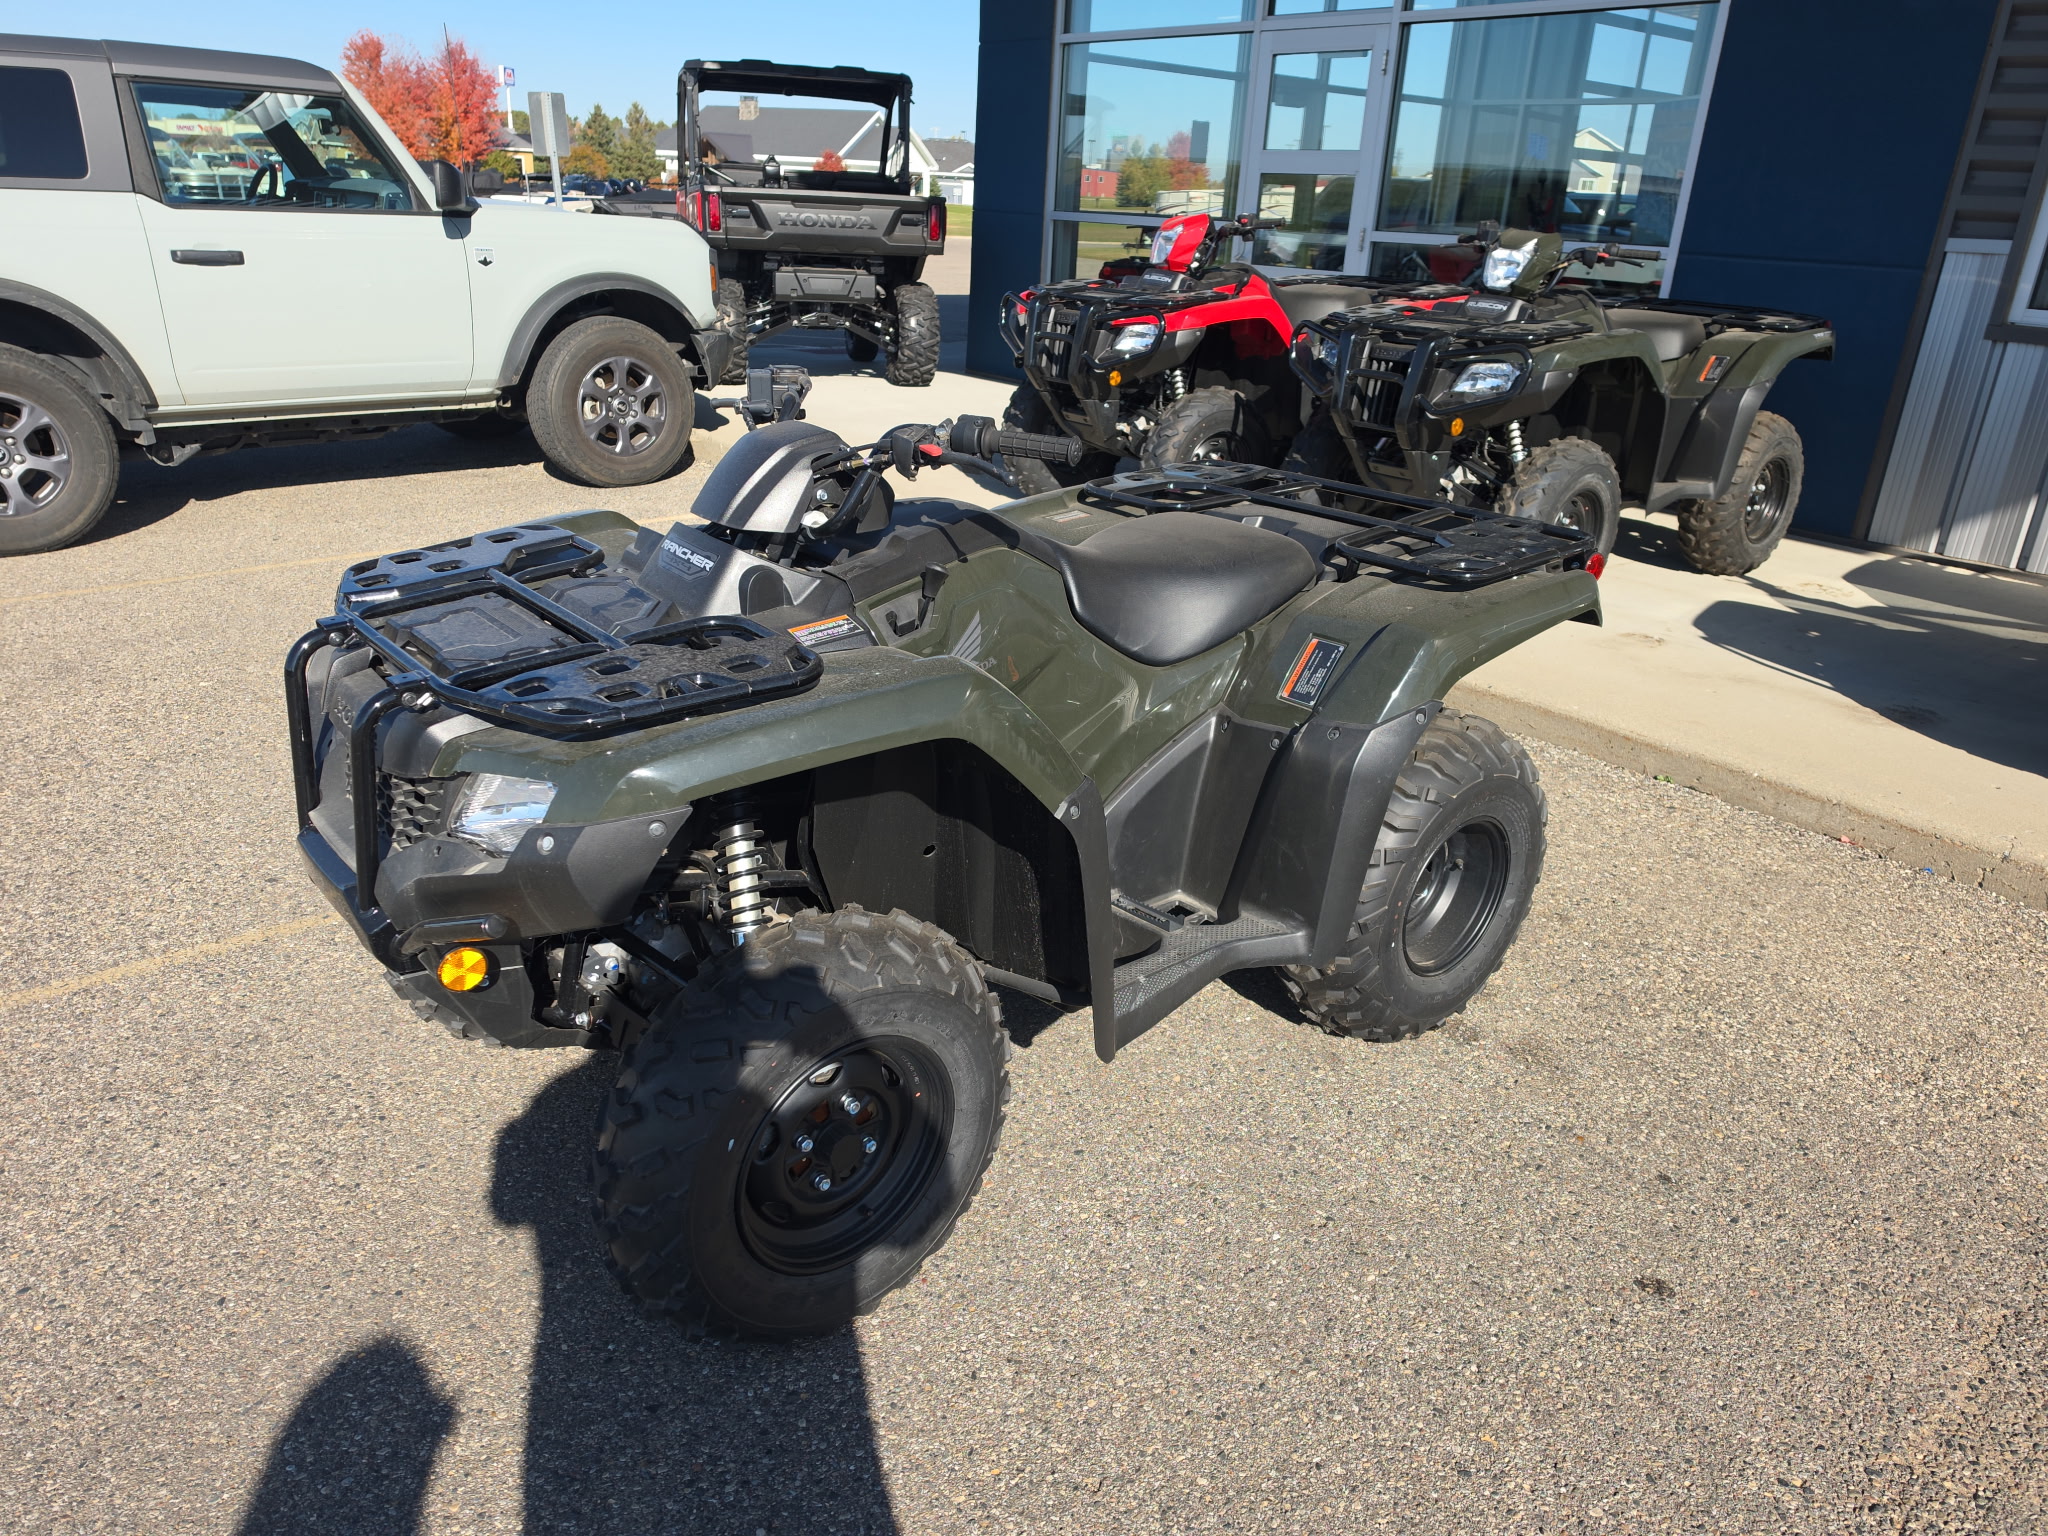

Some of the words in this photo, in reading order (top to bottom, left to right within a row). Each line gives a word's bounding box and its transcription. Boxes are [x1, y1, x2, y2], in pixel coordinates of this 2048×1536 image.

[777, 212, 878, 230] HONDA
[1466, 301, 1508, 311] RUBICON
[661, 539, 715, 572] RANCHER
[1293, 651, 1311, 678] WARNING
